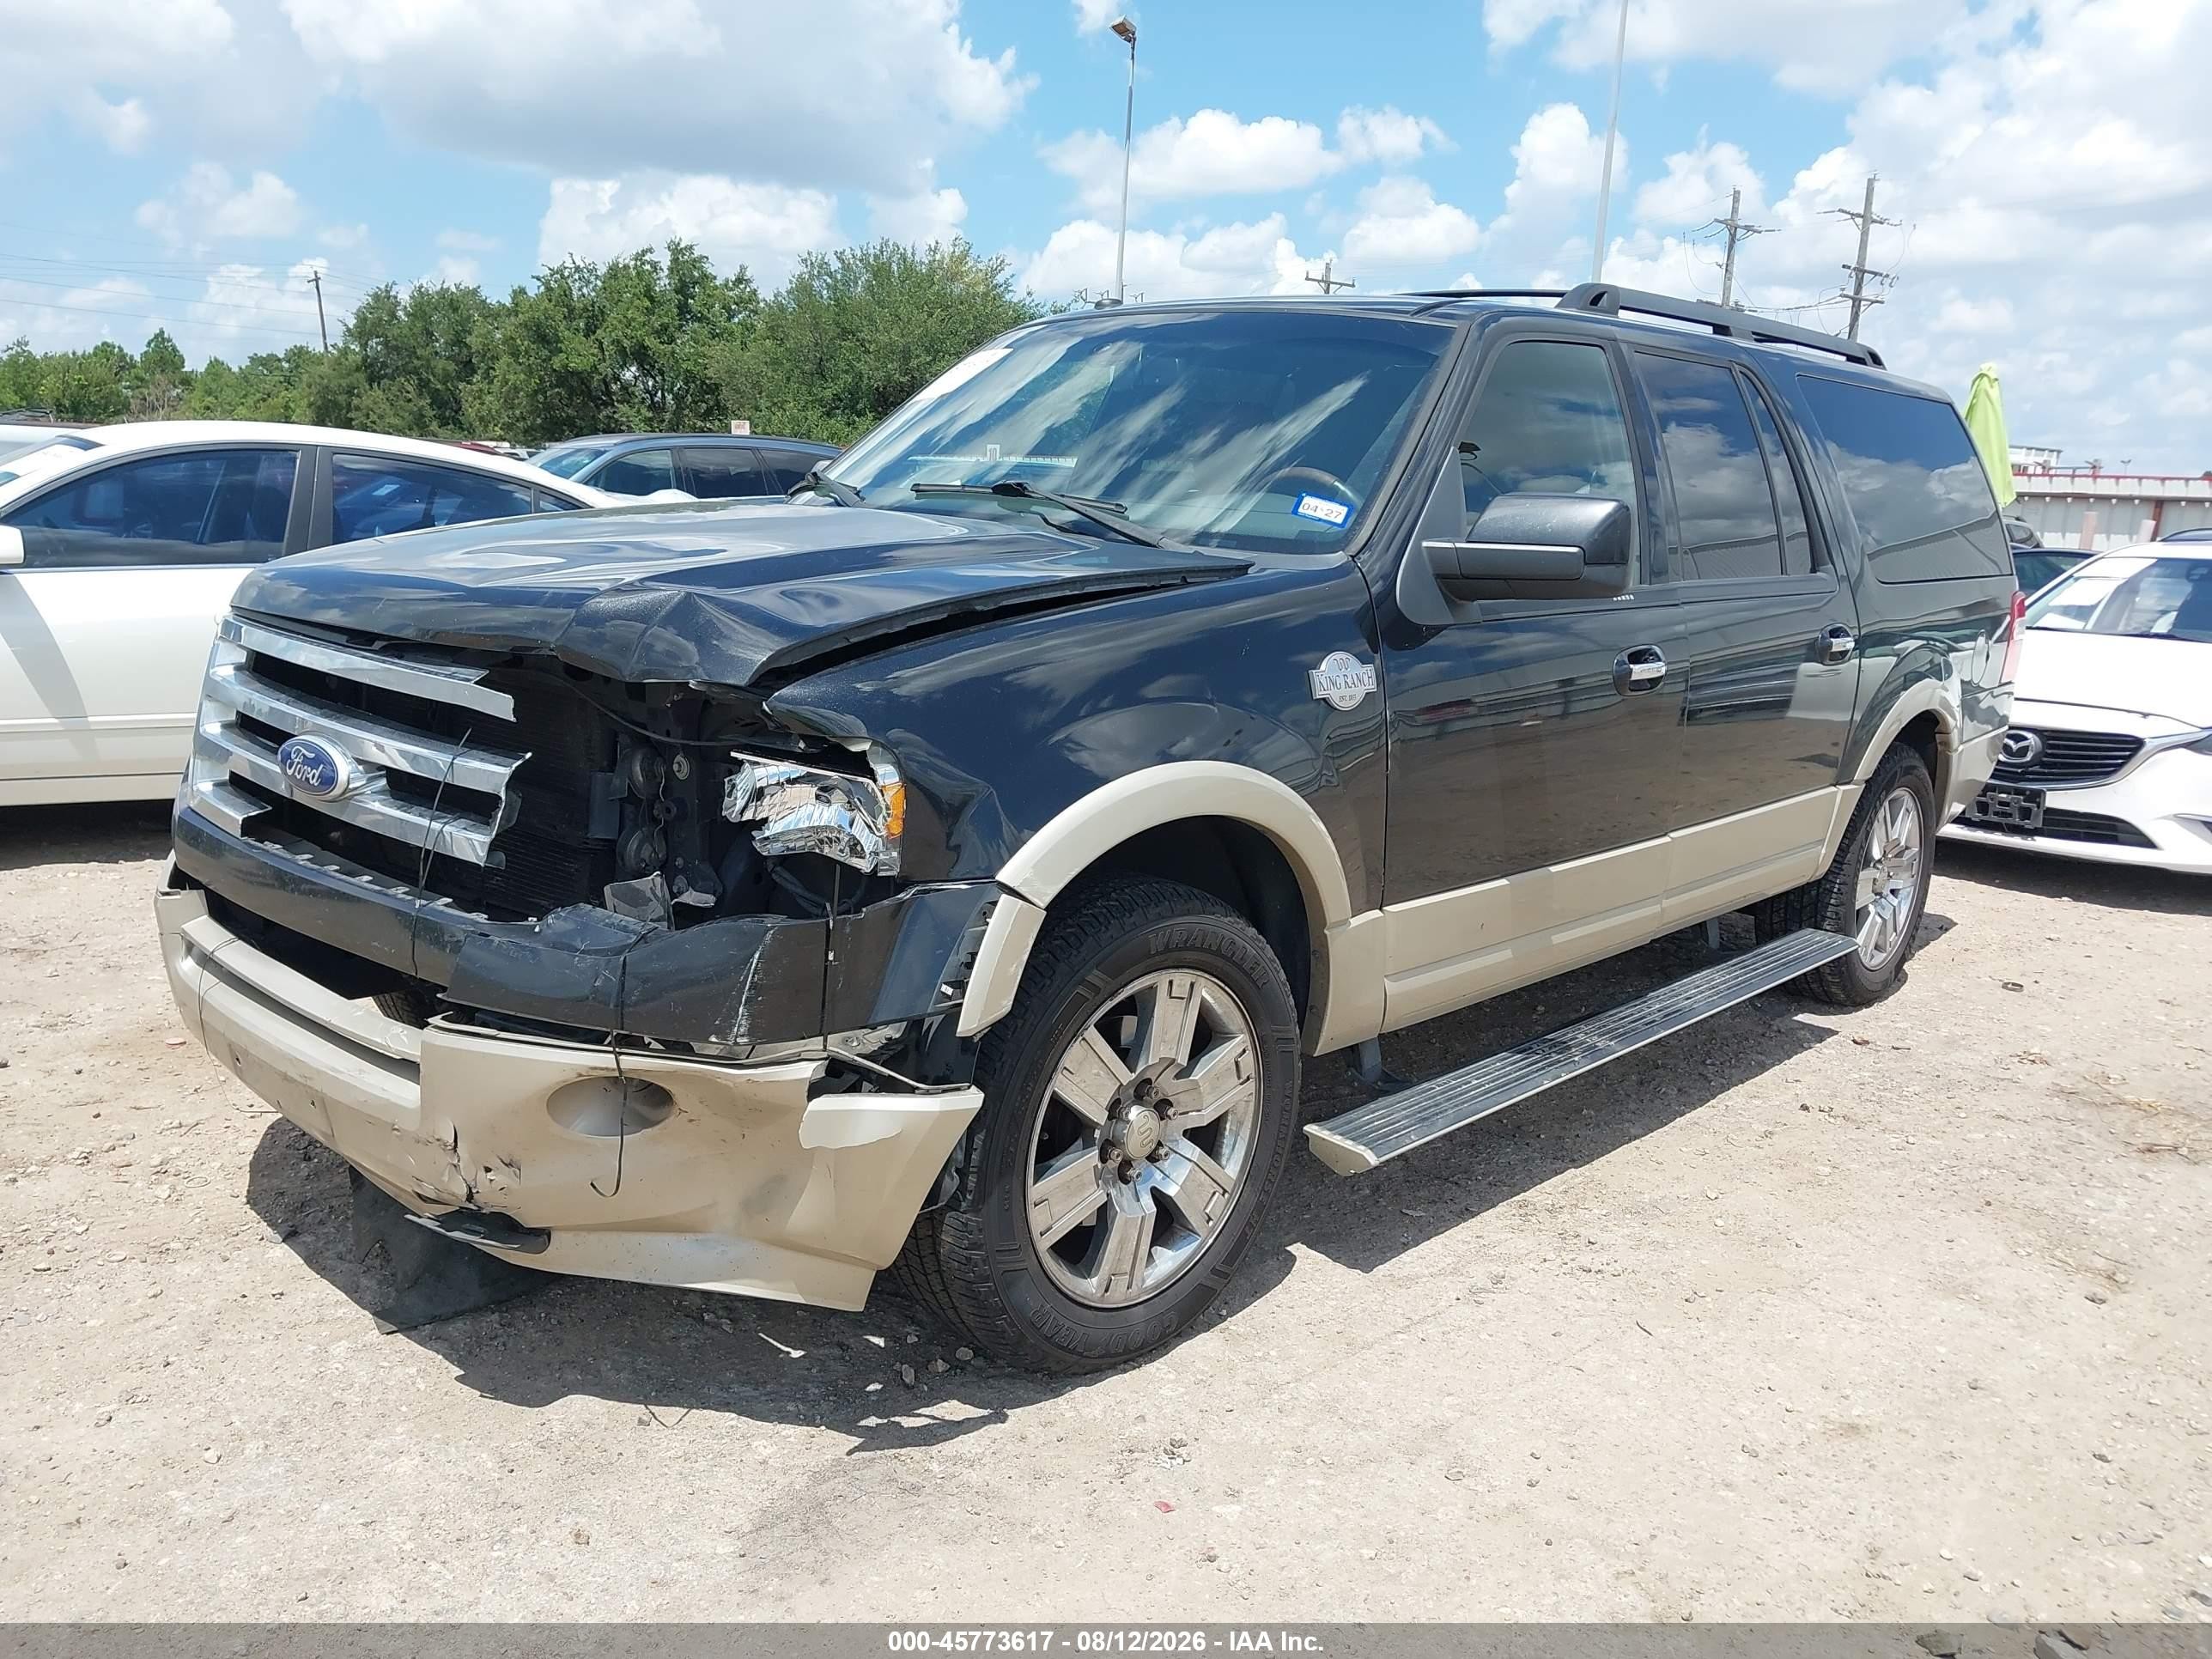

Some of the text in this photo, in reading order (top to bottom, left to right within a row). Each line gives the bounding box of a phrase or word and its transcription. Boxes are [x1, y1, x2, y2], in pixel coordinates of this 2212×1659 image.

[1316, 669, 1374, 692] KING RANCH
[286, 745, 324, 787] Ford
[1147, 927, 1270, 990] WRANGLER
